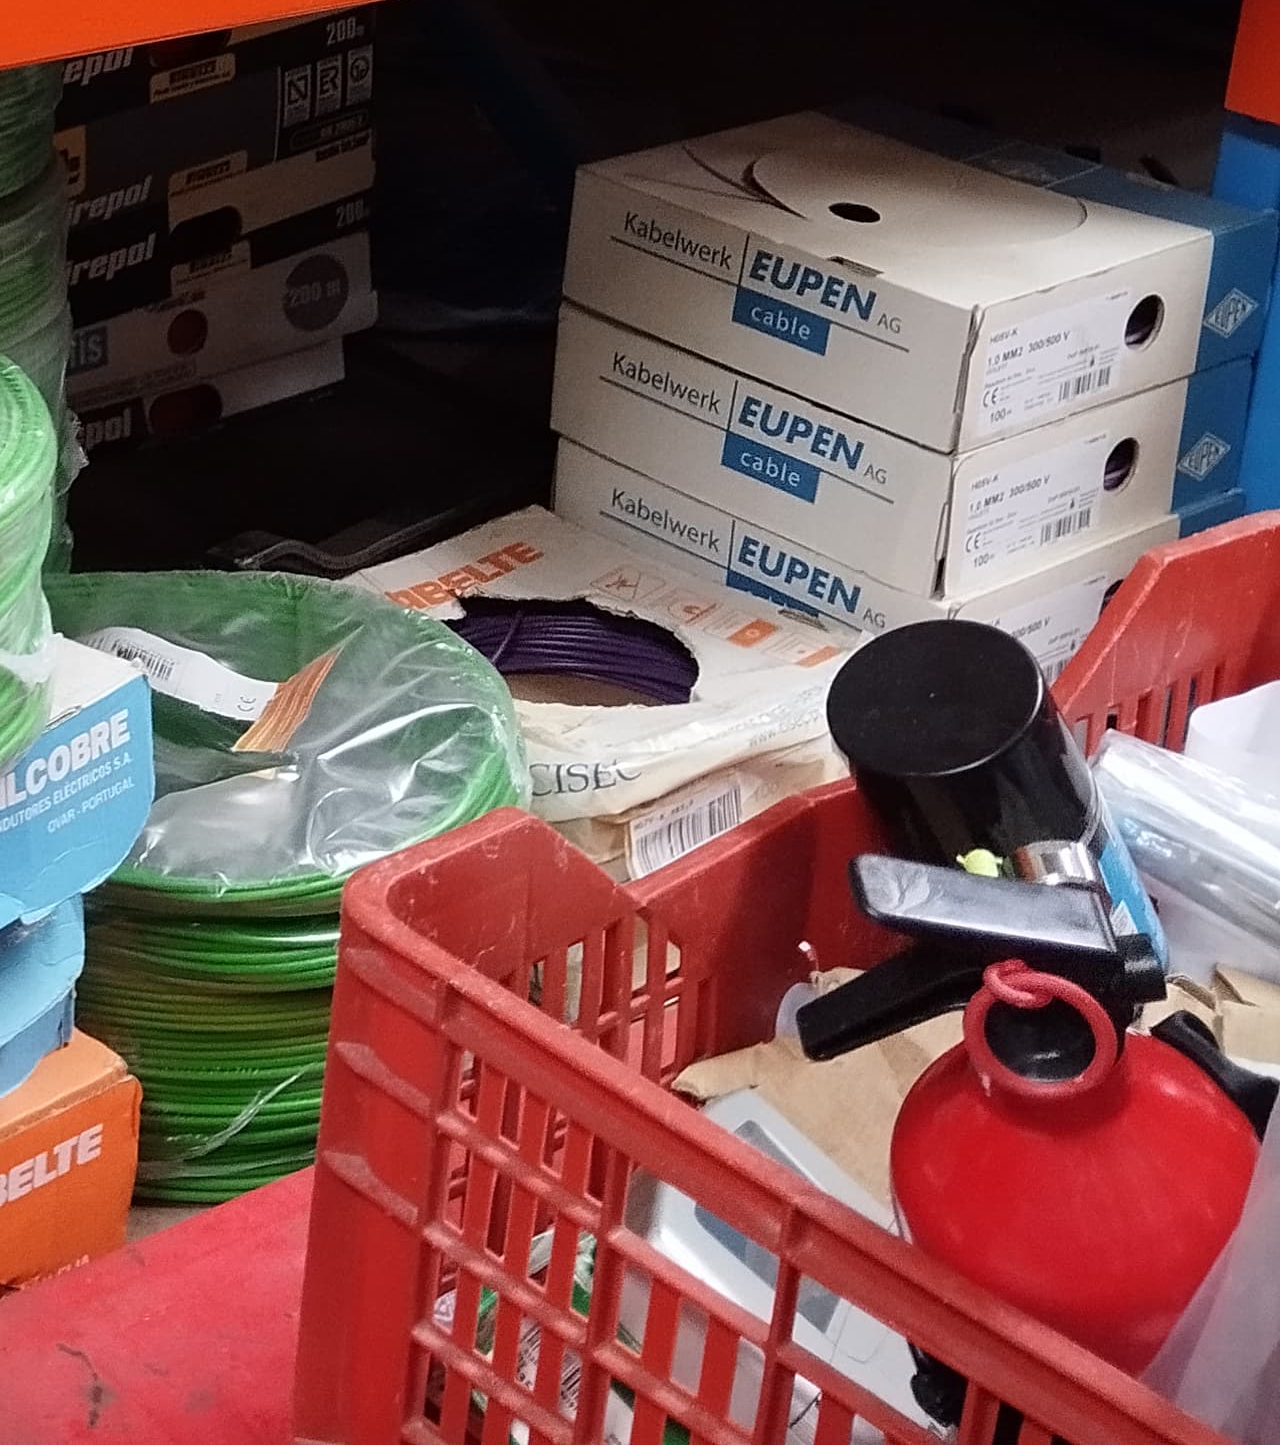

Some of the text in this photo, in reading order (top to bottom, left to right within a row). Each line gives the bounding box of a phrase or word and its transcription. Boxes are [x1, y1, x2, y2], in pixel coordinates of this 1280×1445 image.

[623, 210, 901, 335] Kabelwerk EUPEN AG
[750, 305, 812, 341] cable
[612, 350, 888, 485] Kabelwerk EUPEN AG
[740, 450, 802, 488] cable
[611, 487, 887, 629] Kabelwerk EUPEN AG
[48, 776, 135, 833] OVAR PORTUGAL
